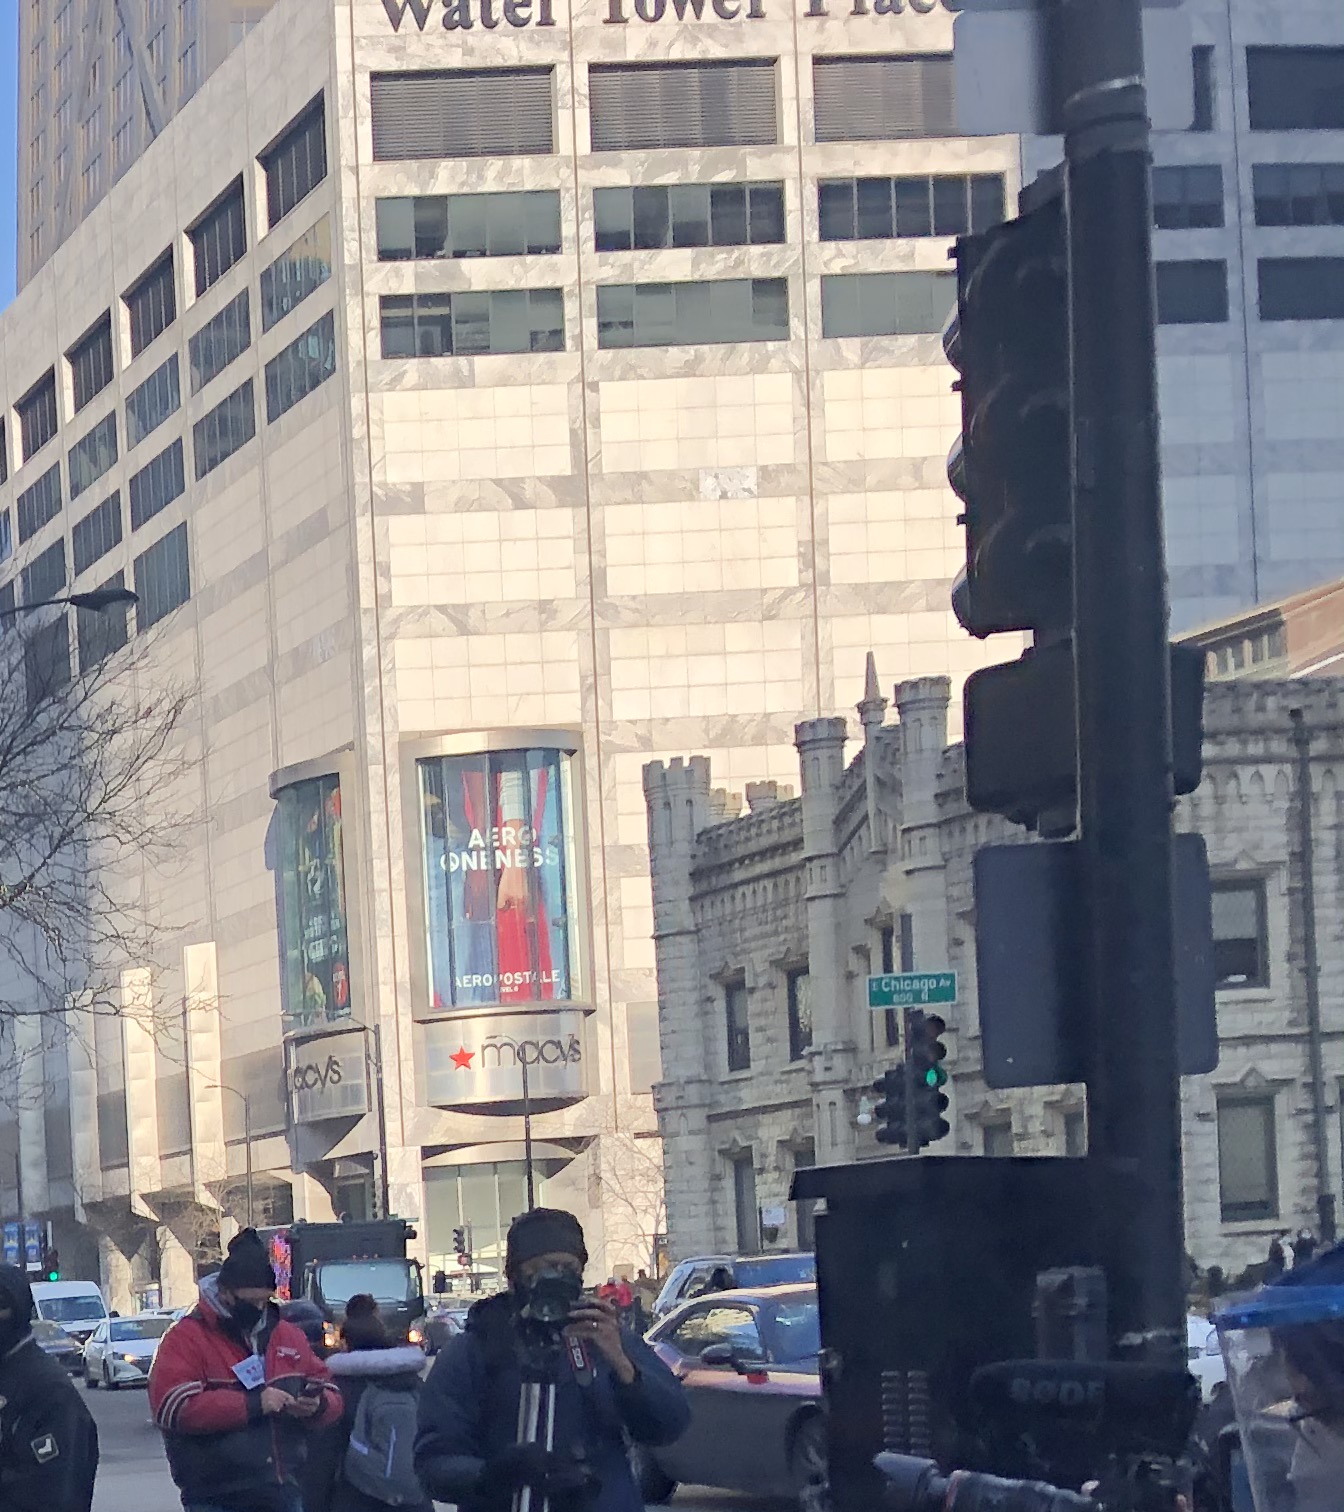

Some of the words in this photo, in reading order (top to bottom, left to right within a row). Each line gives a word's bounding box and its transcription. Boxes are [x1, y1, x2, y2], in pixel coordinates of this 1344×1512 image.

[468, 826, 537, 849] AERO
[440, 846, 559, 873] ONENESS
[881, 978, 936, 992] Chicago
